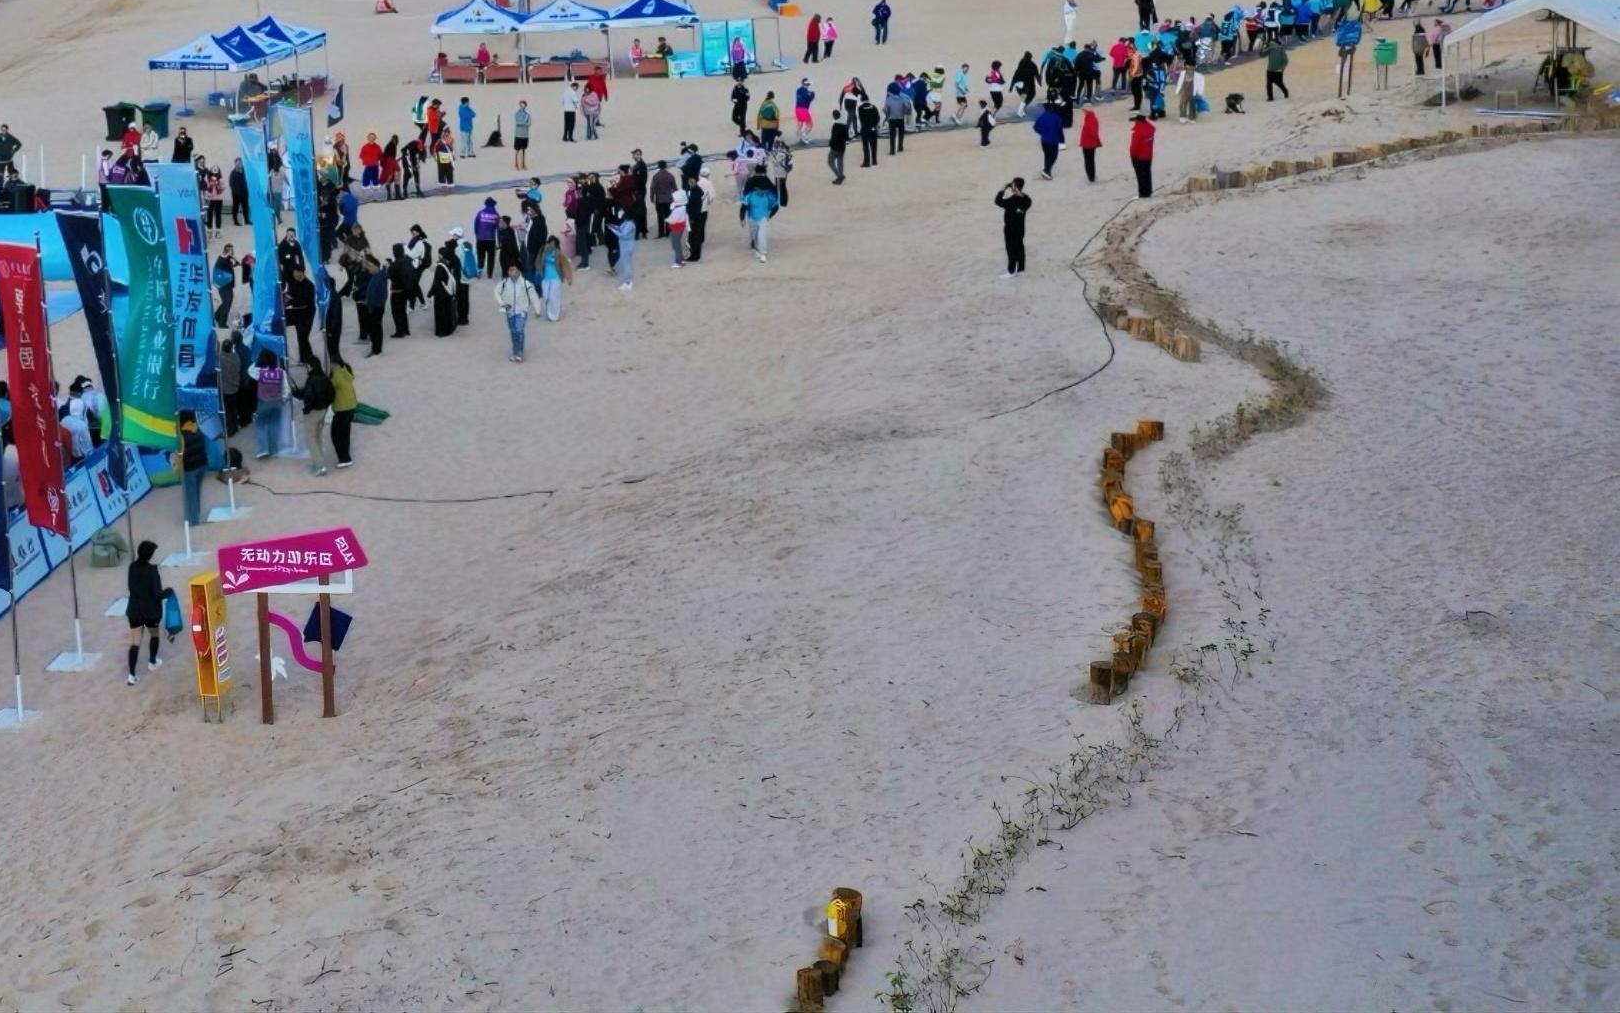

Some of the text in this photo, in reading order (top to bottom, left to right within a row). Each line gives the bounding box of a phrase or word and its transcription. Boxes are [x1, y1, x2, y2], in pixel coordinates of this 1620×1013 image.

[240, 548, 333, 565] 无动力游乐区
